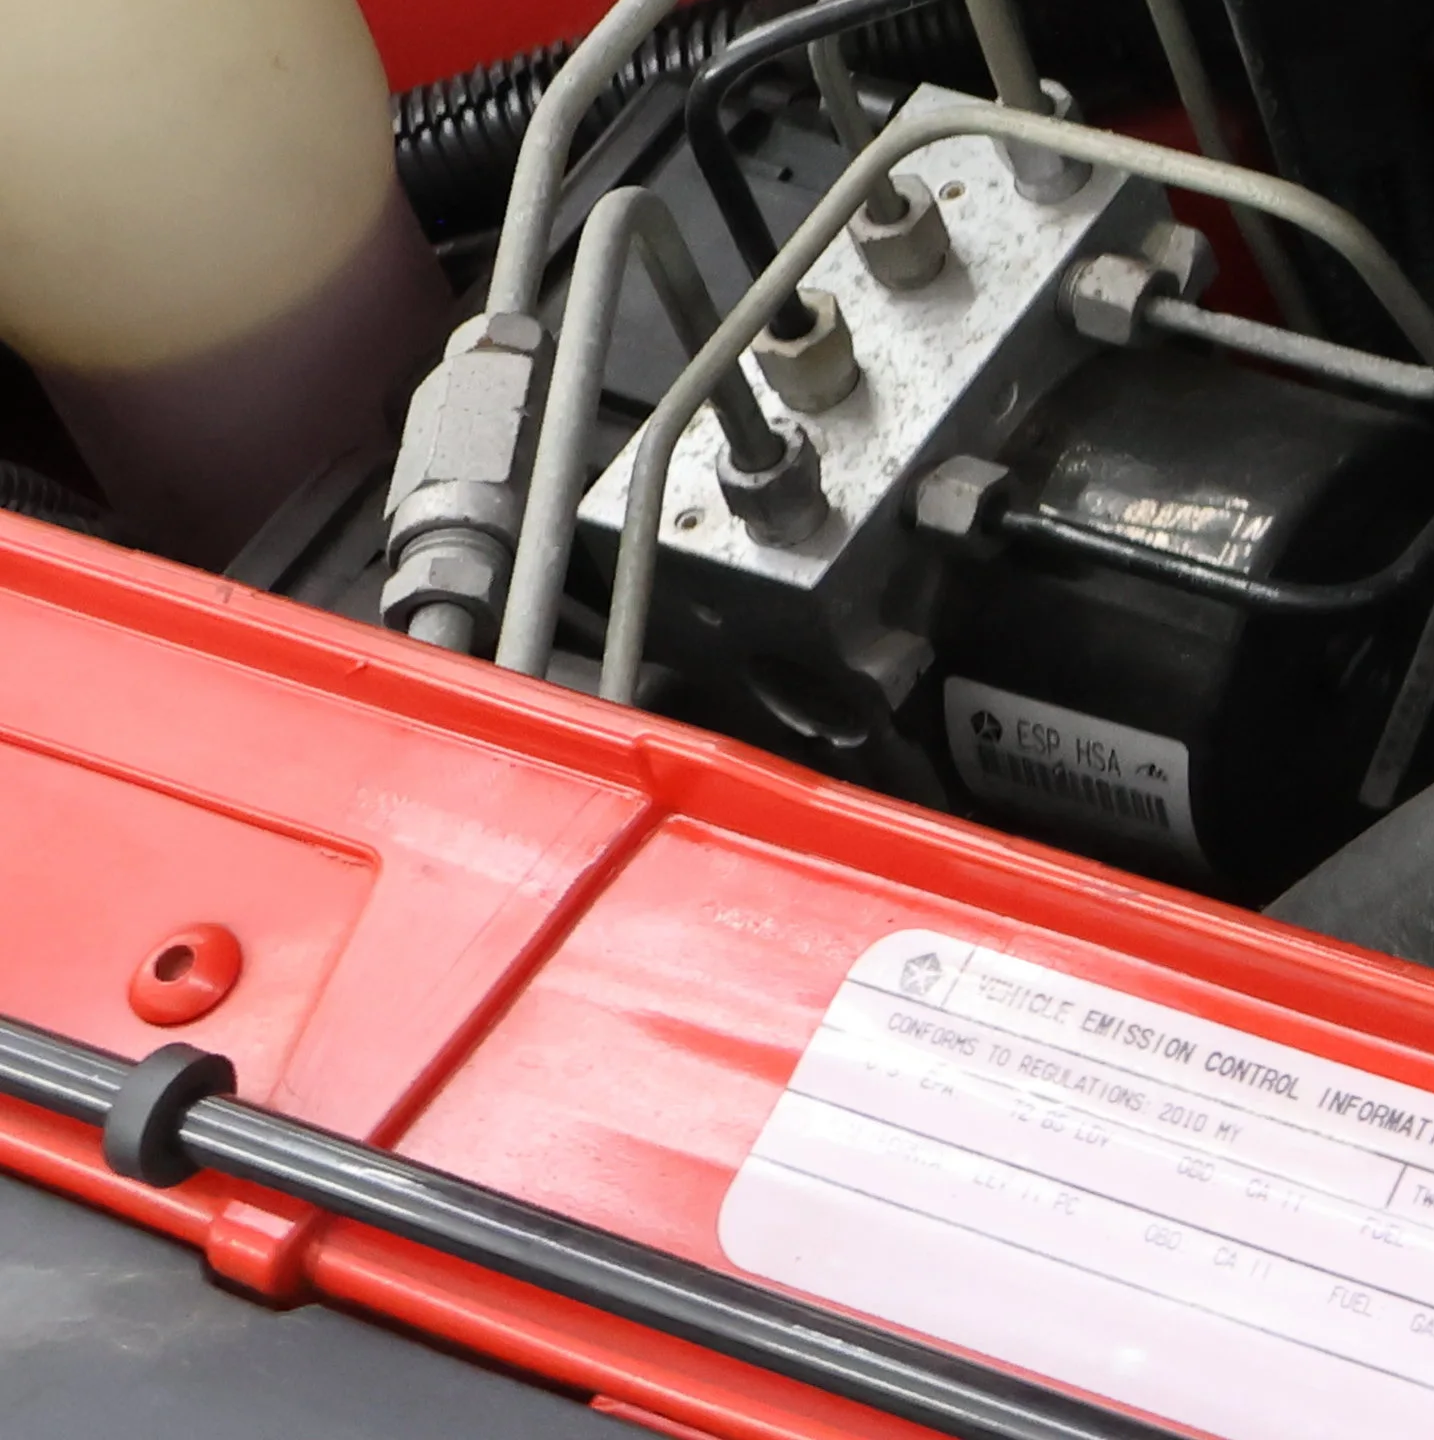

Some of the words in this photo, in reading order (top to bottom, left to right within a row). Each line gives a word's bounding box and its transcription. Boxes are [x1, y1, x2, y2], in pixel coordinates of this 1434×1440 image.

[1015, 717, 1061, 757] ESP
[1075, 736, 1122, 778] HSA
[887, 1011, 980, 1057] CONFORMS
[988, 1043, 1013, 1067] TO
[1018, 1053, 1151, 1115] REGULATIONS:
[1157, 1100, 1208, 1135] 2010
[1214, 1121, 1244, 1146] MY
[977, 973, 1077, 1025] VEHICLE
[1081, 1008, 1198, 1066] EMISSION
[1203, 1050, 1300, 1101] CONTROL
[1212, 1245, 1239, 1269] CA
